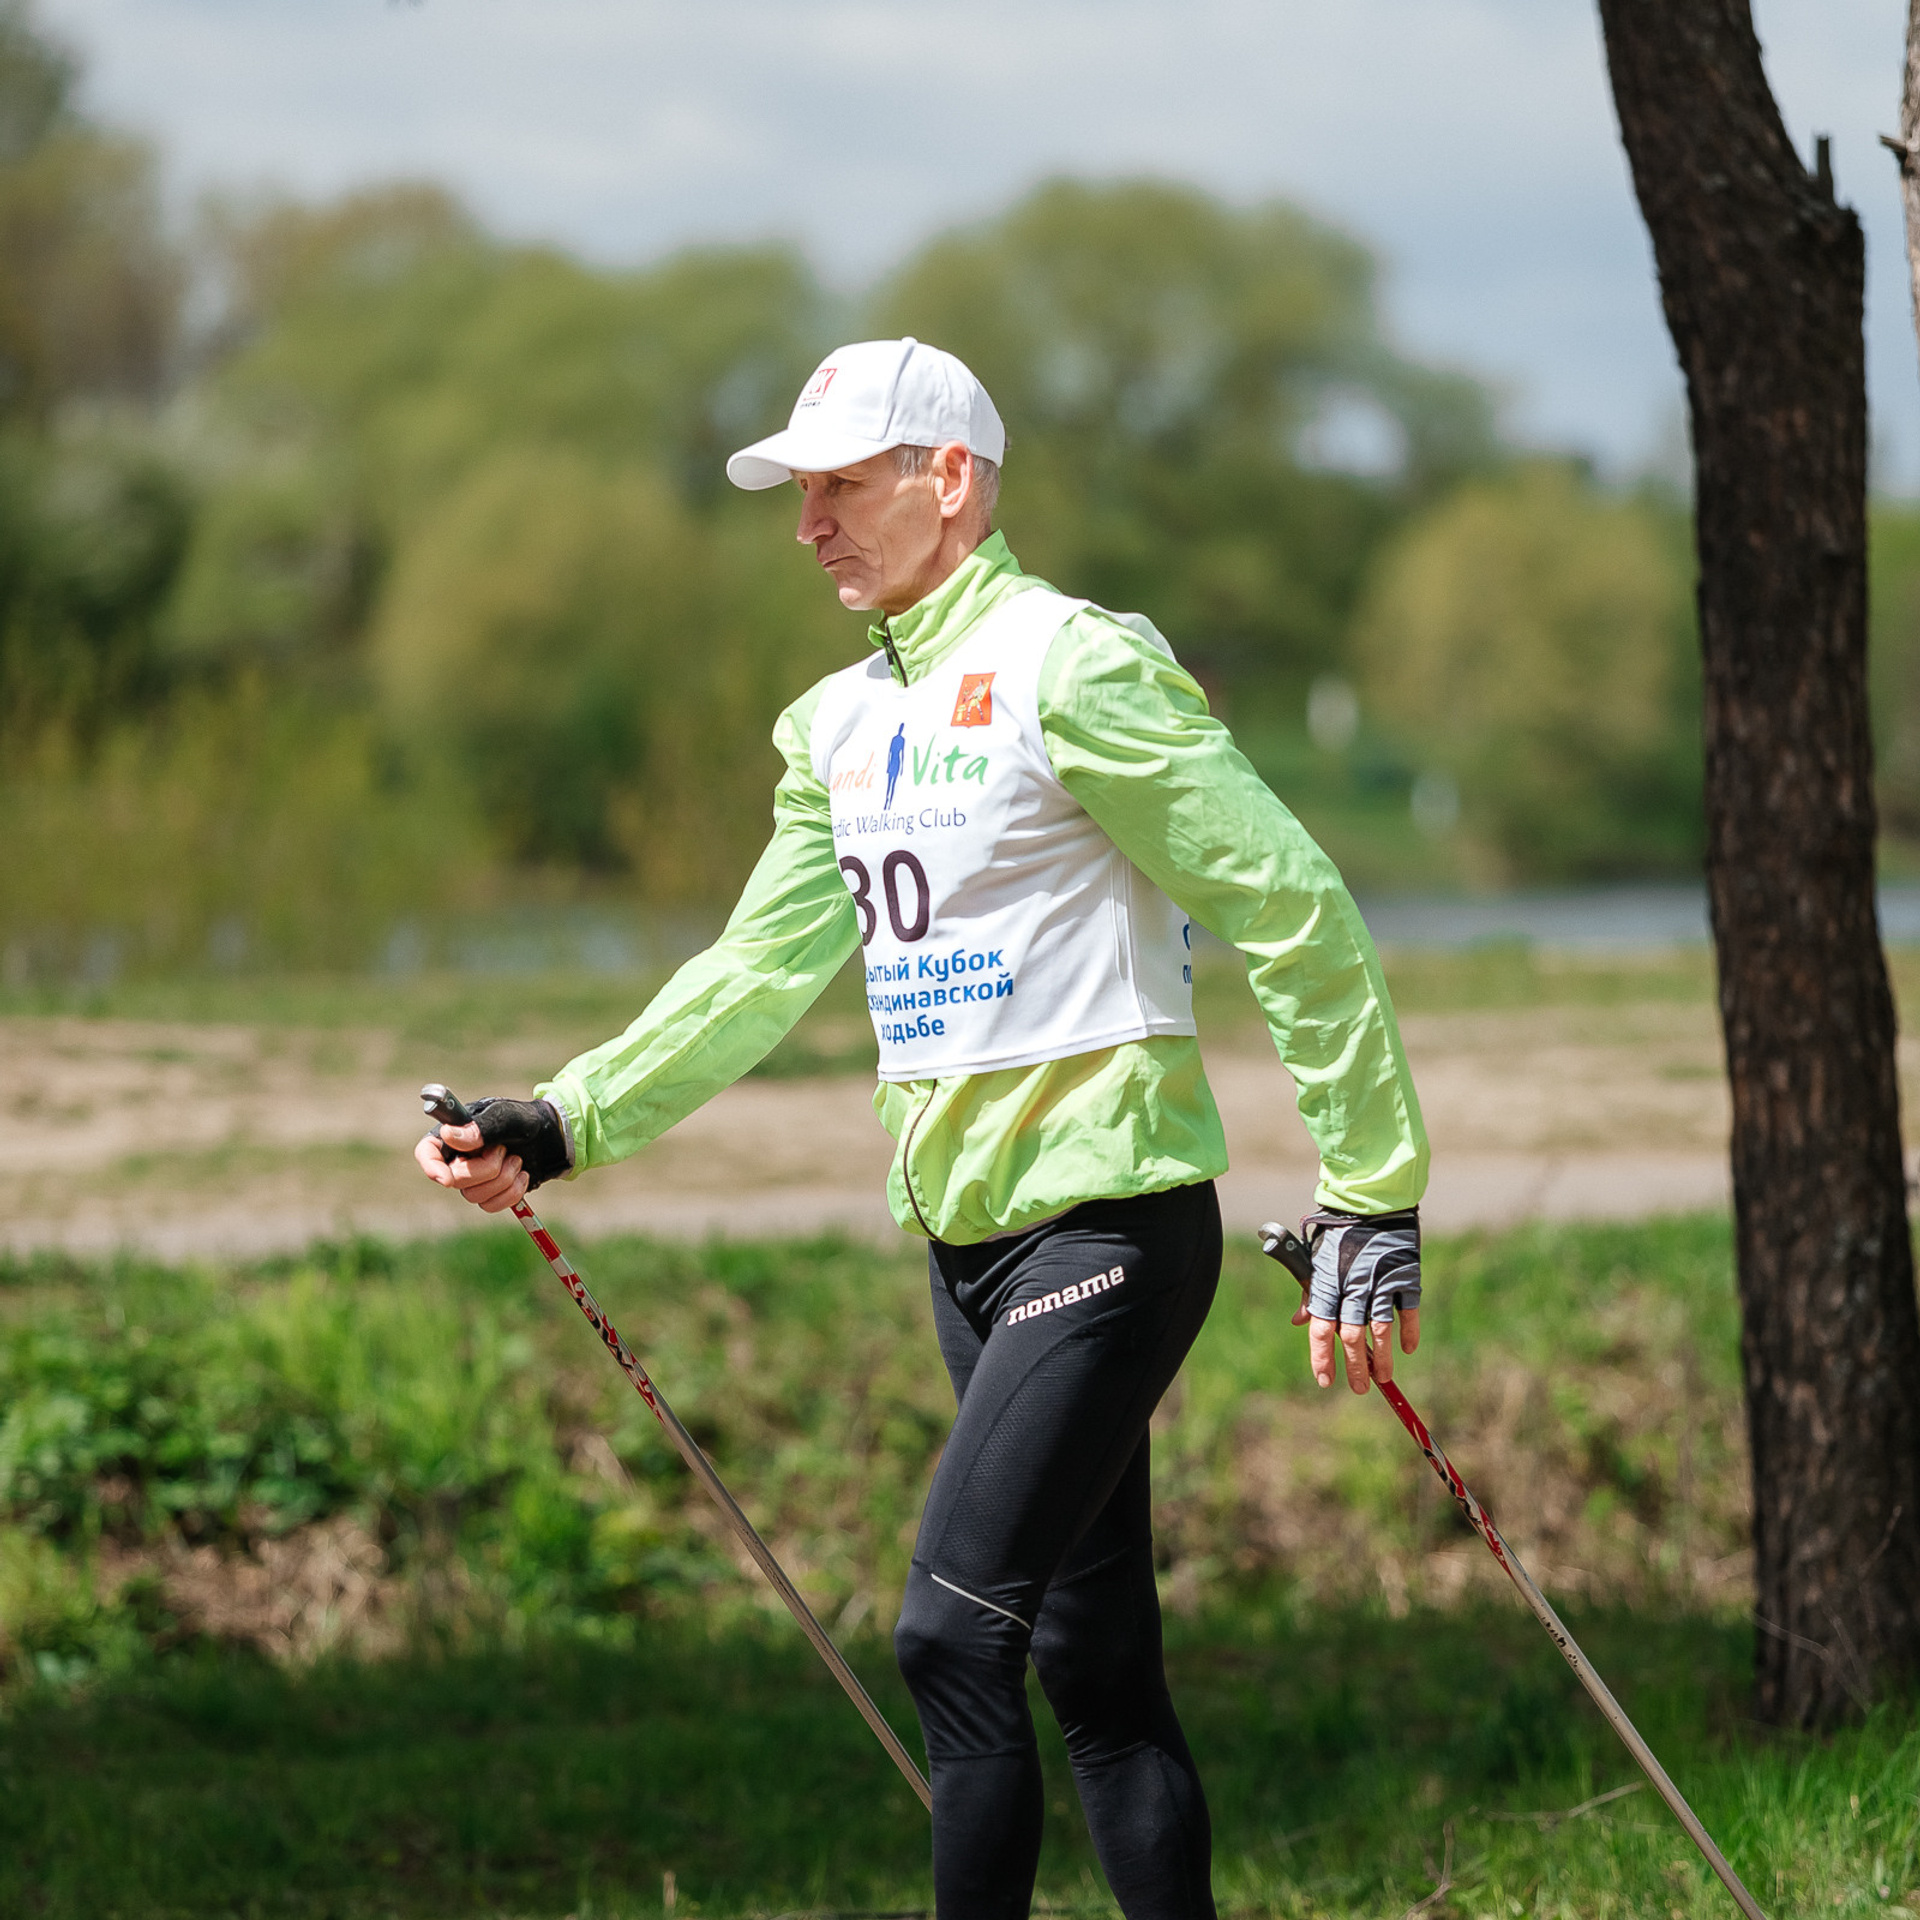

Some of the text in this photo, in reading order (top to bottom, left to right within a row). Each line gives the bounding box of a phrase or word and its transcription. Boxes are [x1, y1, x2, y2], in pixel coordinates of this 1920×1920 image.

[913, 732, 989, 787] Vita
[856, 811, 914, 835] Walking
[918, 807, 967, 828] Club
[917, 949, 1004, 982] Кубок
[881, 1014, 945, 1045] ходьбе
[1006, 1265, 1125, 1326] noname
